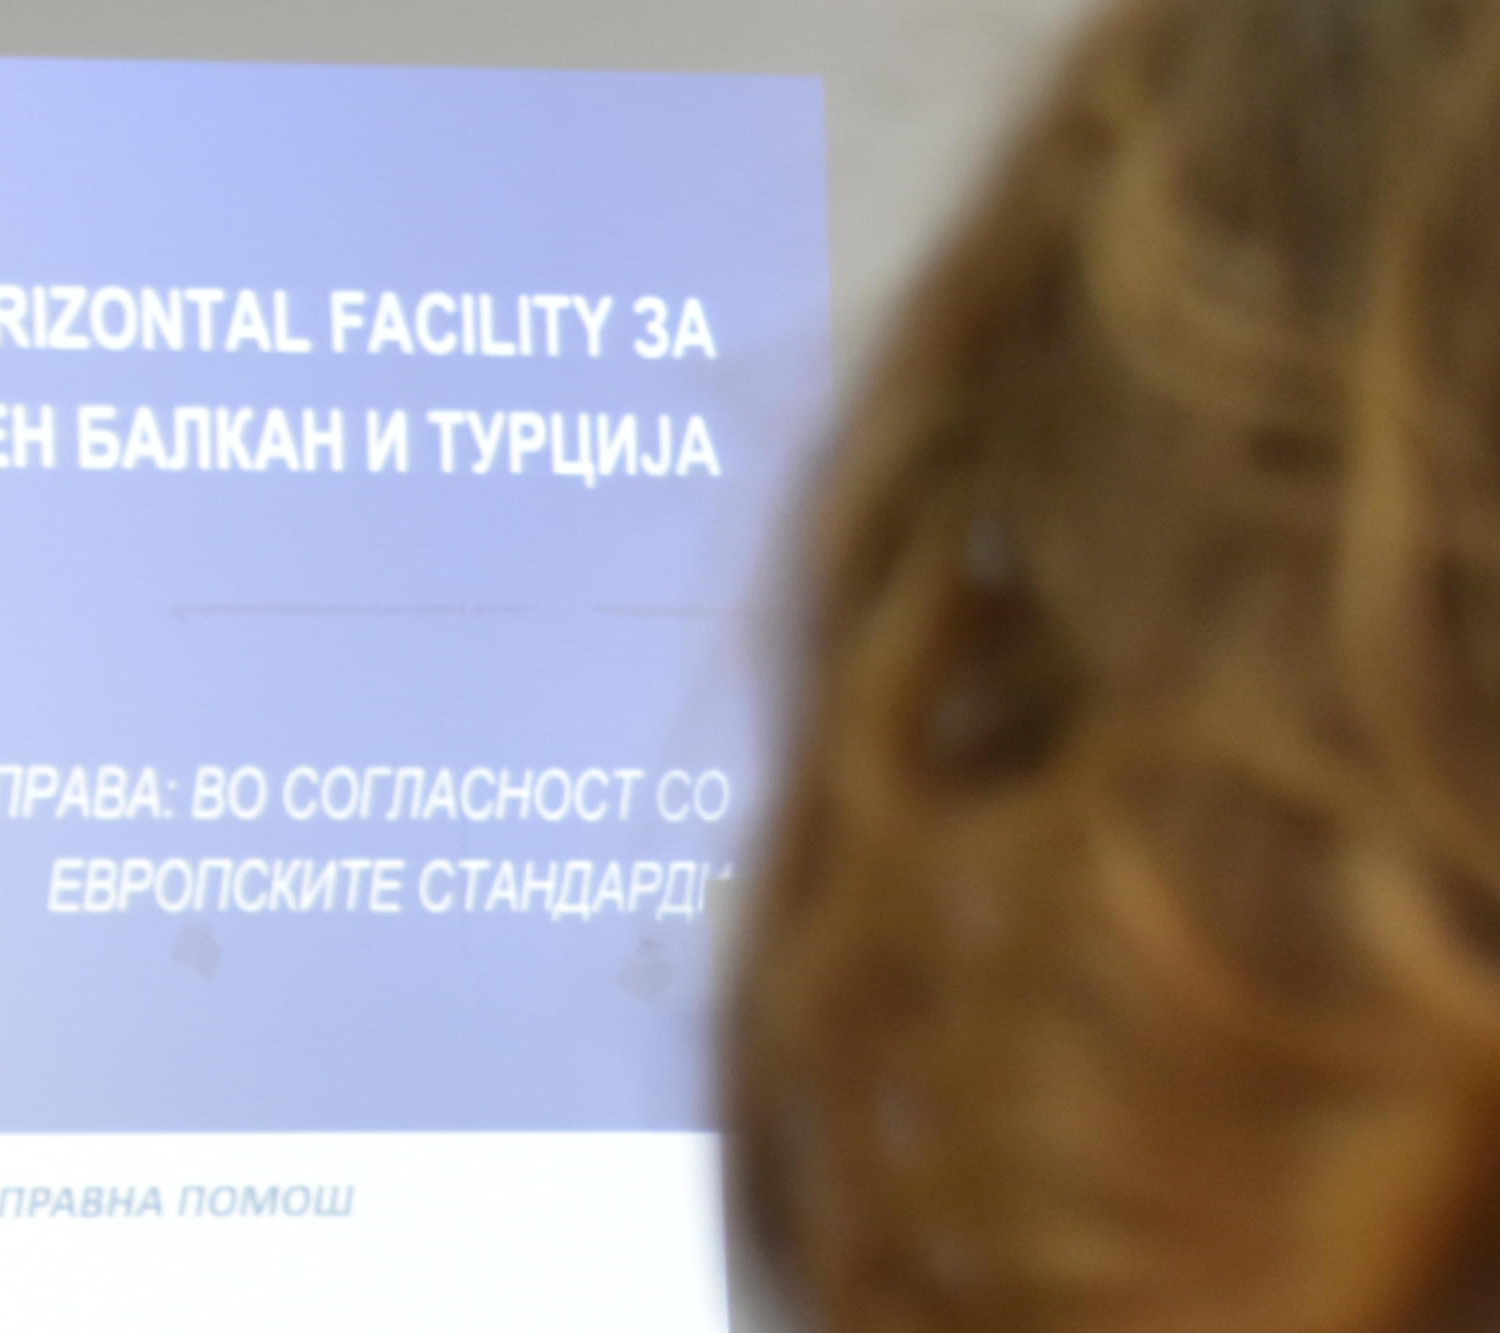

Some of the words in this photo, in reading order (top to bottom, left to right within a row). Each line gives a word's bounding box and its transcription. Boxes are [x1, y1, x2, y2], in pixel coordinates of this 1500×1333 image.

[329, 291, 615, 357] FACILITY
[632, 297, 718, 360] ЗА
[77, 405, 346, 474] БАЛКАН
[366, 409, 410, 475] И
[427, 410, 722, 489] ТУРЦИЈА
[192, 766, 268, 822] ВО
[282, 766, 646, 823] СОГЛАСНОСТ
[656, 768, 732, 823] СО
[46, 857, 405, 915] ЕВРОПСКИТЕ
[178, 1183, 355, 1218] ПОМОШ
